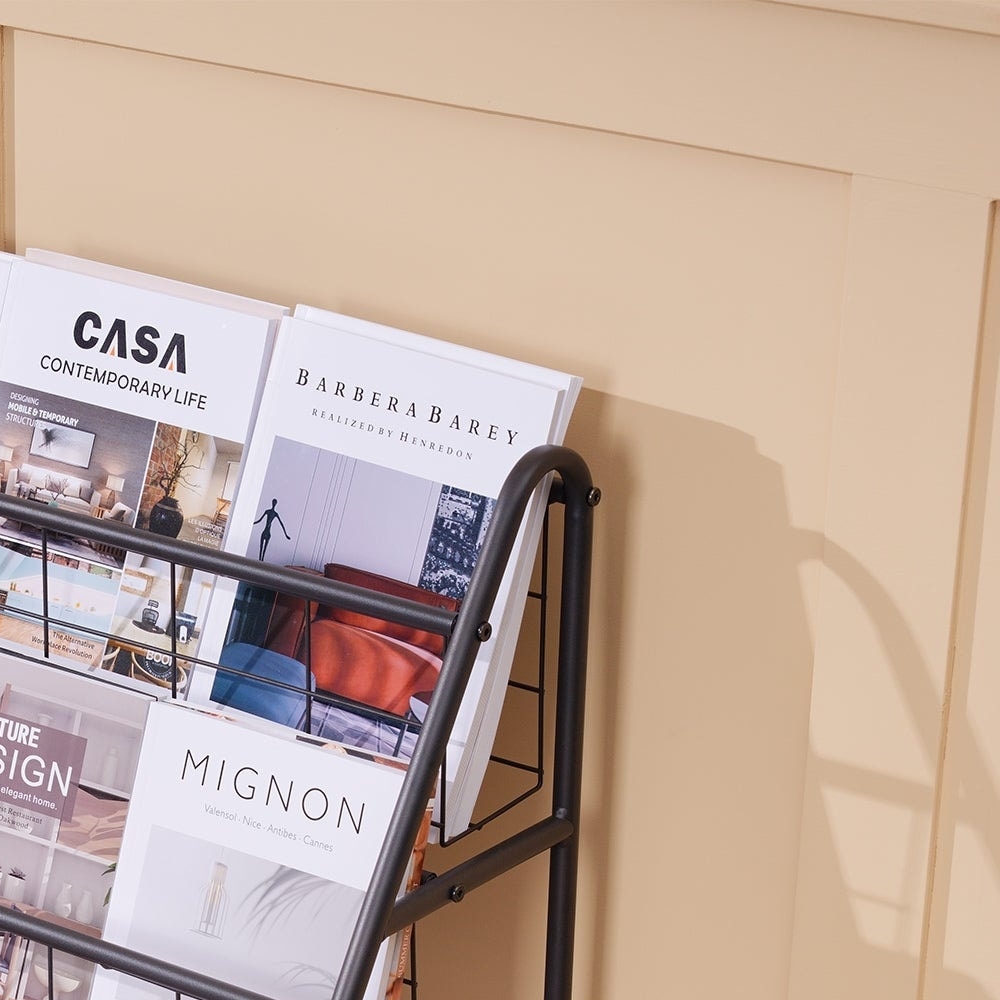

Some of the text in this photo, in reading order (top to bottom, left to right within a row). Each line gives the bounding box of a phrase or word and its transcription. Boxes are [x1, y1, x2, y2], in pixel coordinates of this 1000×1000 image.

[73, 311, 187, 374] CASA
[40, 355, 208, 410] CONTEMPORARY LIFE
[10, 392, 39, 405] DESIGNING
[295, 368, 518, 446] BARBERA BAREY
[5, 412, 47, 430] STRUCTUR
[8, 402, 79, 427] MOBILE & TEMPORARY
[312, 408, 473, 461] REALIZED BY HENREDON
[53, 631, 95, 650] The Alternative
[62, 645, 93, 660] Revolution
[0, 785, 32, 804] elegant
[33, 795, 58, 811] home.
[181, 749, 365, 835] MIGNON
[7, 807, 43, 825] Restaurant
[204, 804, 334, 852] Valensol Nice Antibes Cannes
